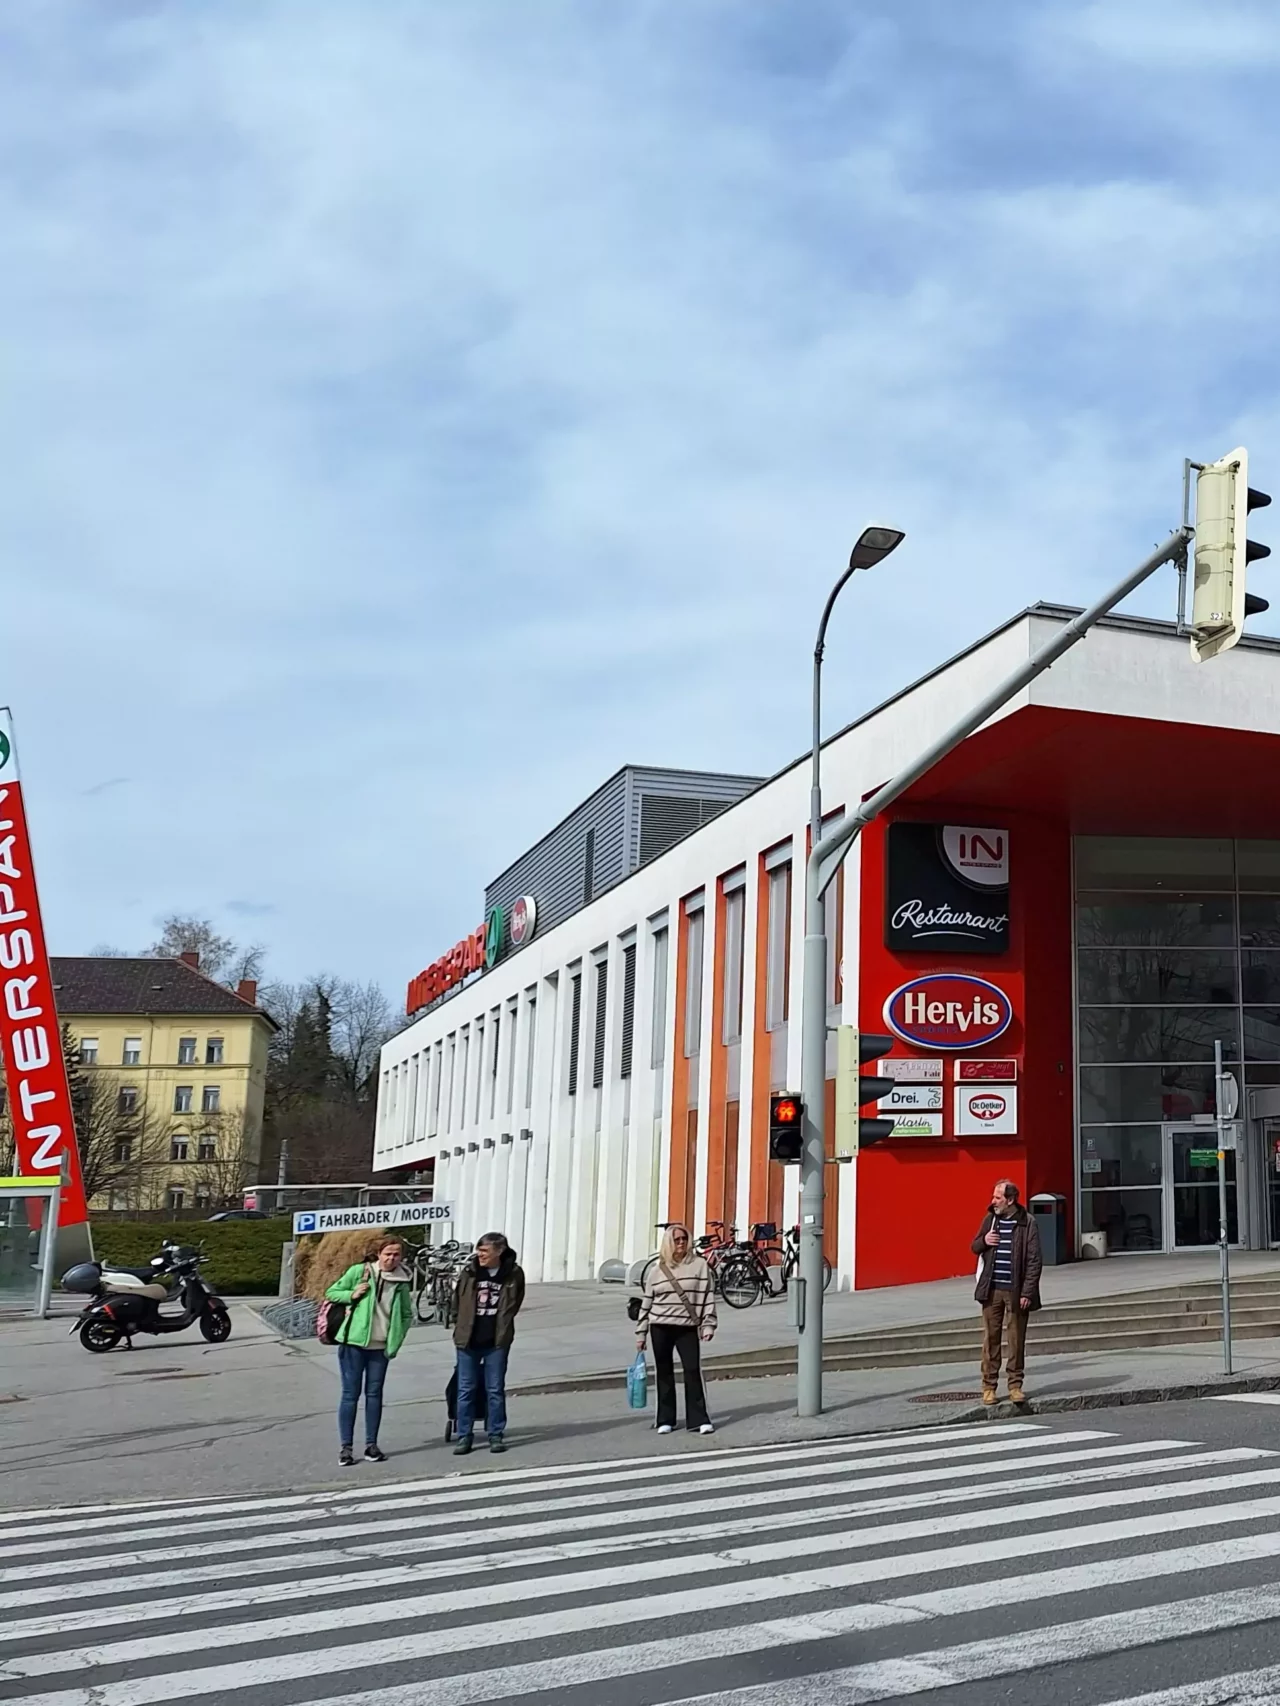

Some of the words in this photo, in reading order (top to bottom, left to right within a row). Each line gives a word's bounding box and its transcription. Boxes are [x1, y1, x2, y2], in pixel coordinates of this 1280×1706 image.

[959, 833, 1003, 861] IN
[891, 899, 1010, 933] Restaurant
[0, 788, 63, 1170] NTERSPA
[904, 992, 1000, 1032] Hervis
[891, 1092, 920, 1104] Drei.
[301, 1214, 314, 1231] P
[319, 1209, 389, 1228] FAHRRÄDER
[392, 1210, 399, 1223] /
[401, 1206, 450, 1221] MOPEDS
